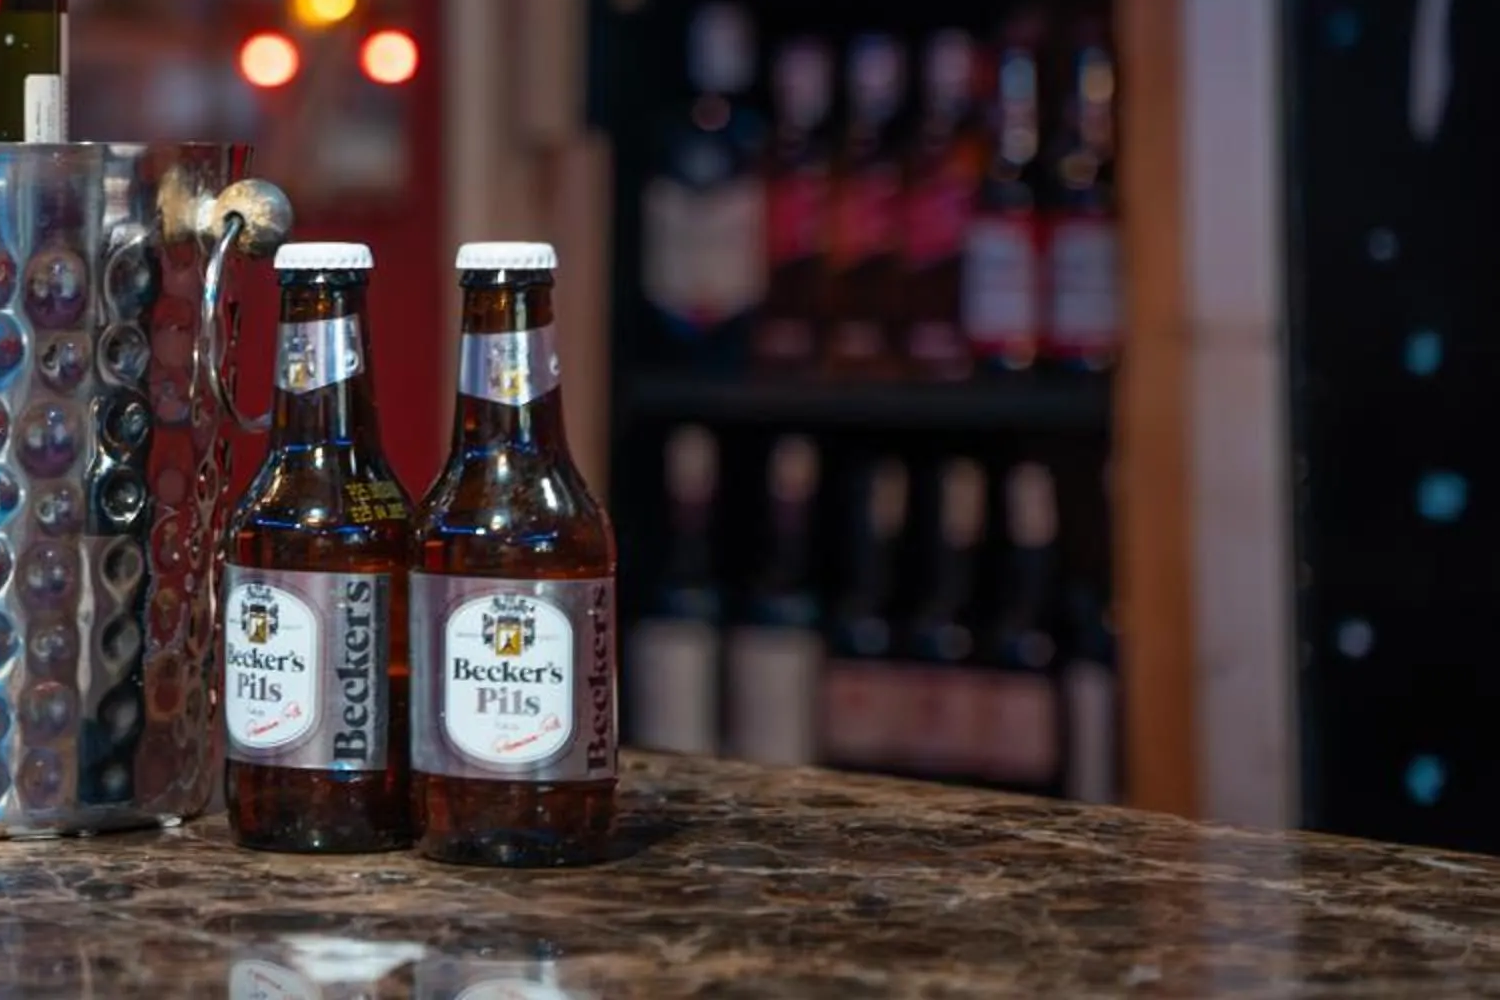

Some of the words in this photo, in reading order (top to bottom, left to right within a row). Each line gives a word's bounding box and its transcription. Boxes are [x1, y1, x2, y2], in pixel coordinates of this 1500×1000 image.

[227, 642, 305, 673] Becker's
[452, 657, 564, 685] Becker's
[236, 672, 283, 703] Pils
[475, 686, 541, 717] Pils
